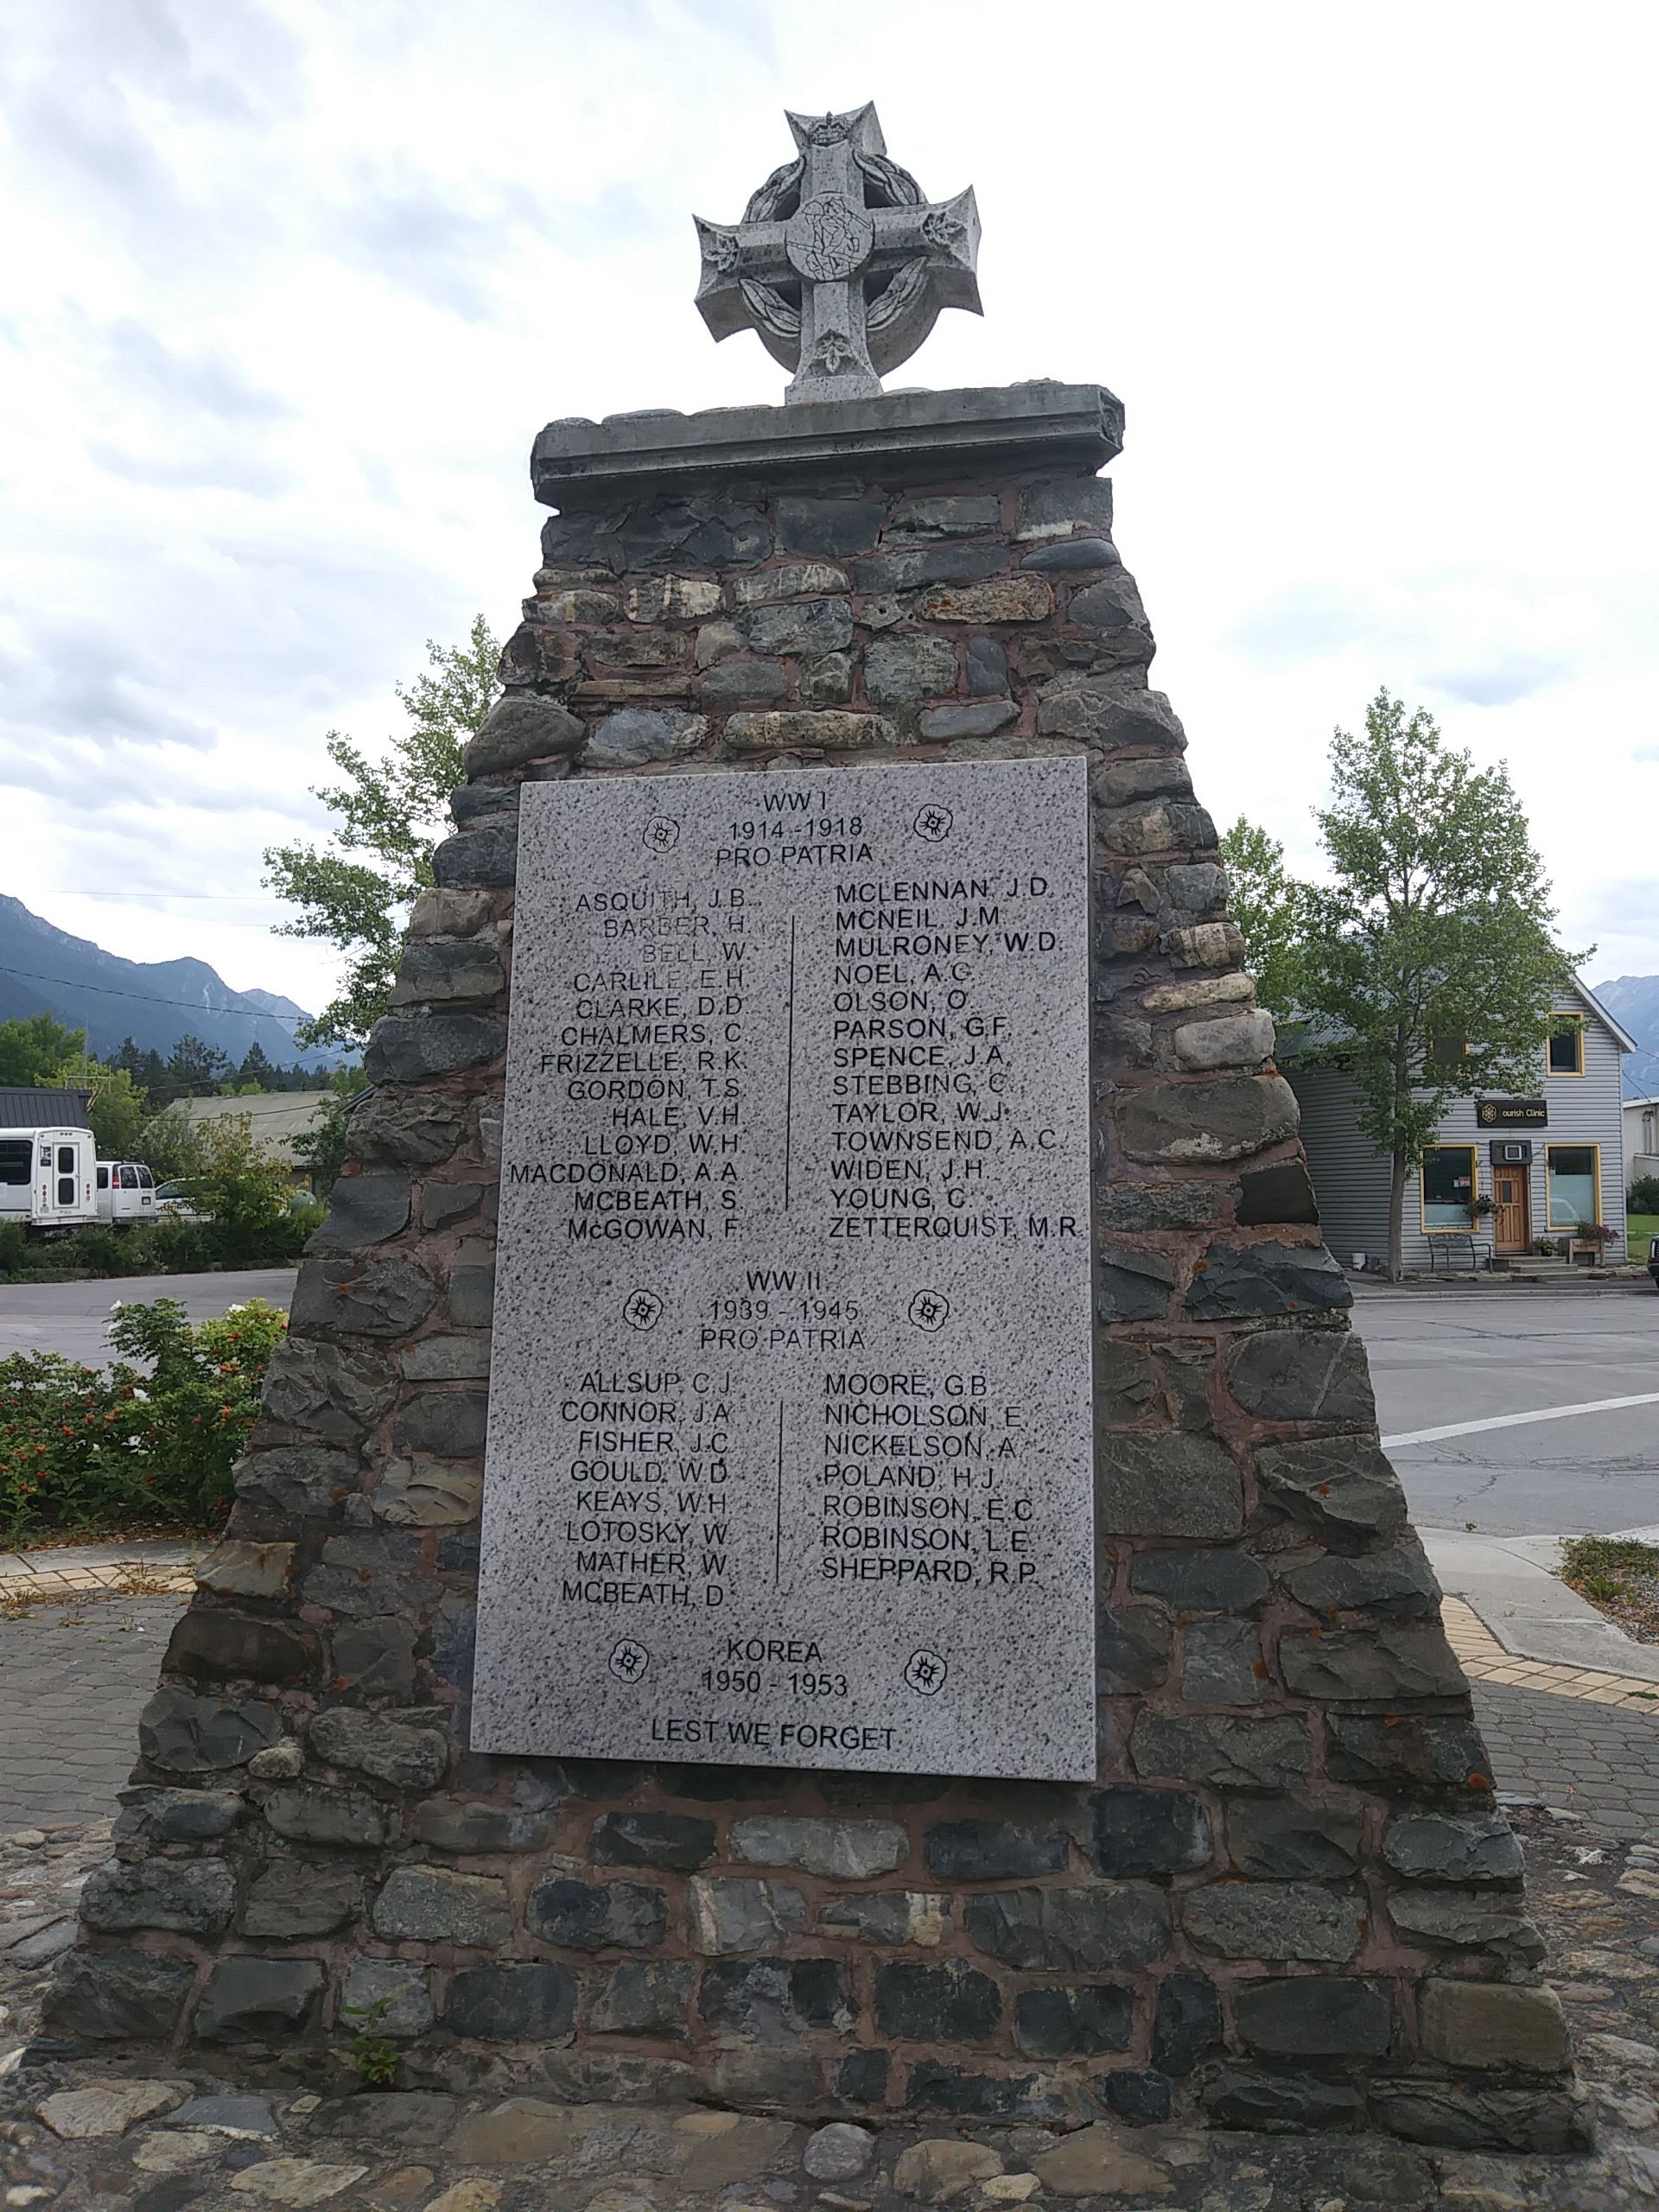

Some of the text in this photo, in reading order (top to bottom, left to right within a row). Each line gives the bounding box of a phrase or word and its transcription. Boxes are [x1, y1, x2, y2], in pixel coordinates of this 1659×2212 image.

[763, 791, 811, 812] WW
[728, 821, 784, 840] 1914
[716, 843, 873, 867] PRO PATRIA
[575, 890, 697, 913] ASQUITH,
[836, 908, 944, 931] MCNEIL,
[643, 943, 711, 965] BELL,
[836, 931, 1064, 957] MULRONEY, W.D.
[700, 969, 750, 988] E.H.
[835, 963, 914, 985] NOEL,
[576, 995, 749, 1020] CLARKE, D.D.
[834, 989, 974, 1014] OLSON, O.
[562, 1024, 714, 1046] CHALMERS,
[834, 1017, 1013, 1040] PARSON, G.F.
[541, 1050, 748, 1073] FRIZZELLE, R.K.
[834, 1046, 953, 1068] SPENCE,
[568, 1079, 691, 1102] GORDON,
[833, 1073, 977, 1096] STEBBING,
[613, 1106, 687, 1128] HALE,
[832, 1102, 945, 1125] TAYLOR,
[1525, 1109, 1545, 1117] Clinic
[585, 1134, 746, 1157] LLOYD, W.H.
[831, 1130, 1001, 1154] TOWNSEND,
[510, 1162, 746, 1185] MACDONALD, A.A.
[831, 1159, 990, 1182] WIDEN, J.H.
[575, 1190, 709, 1213] MCBEATH,
[830, 1188, 973, 1211] YOUNG, C.
[569, 1218, 713, 1242] McGOWAN,
[829, 1216, 1017, 1239] ZETTERQUIST,
[747, 1270, 820, 1291] WW II
[709, 1300, 768, 1320] 1939
[799, 1300, 859, 1320] 1945
[701, 1329, 865, 1351] PRO PATRIA
[826, 1374, 935, 1399] MOORE,
[824, 1465, 943, 1491] POLAND,
[824, 1495, 977, 1522] ROBINSON,
[823, 1526, 979, 1554] ROBINSON,
[822, 1557, 981, 1586] SHEPPARD,
[728, 1639, 822, 1663] KOREA
[702, 1669, 761, 1693] 1950
[788, 1673, 848, 1696] 1953
[652, 1719, 897, 1751] LEST WE FORGET
